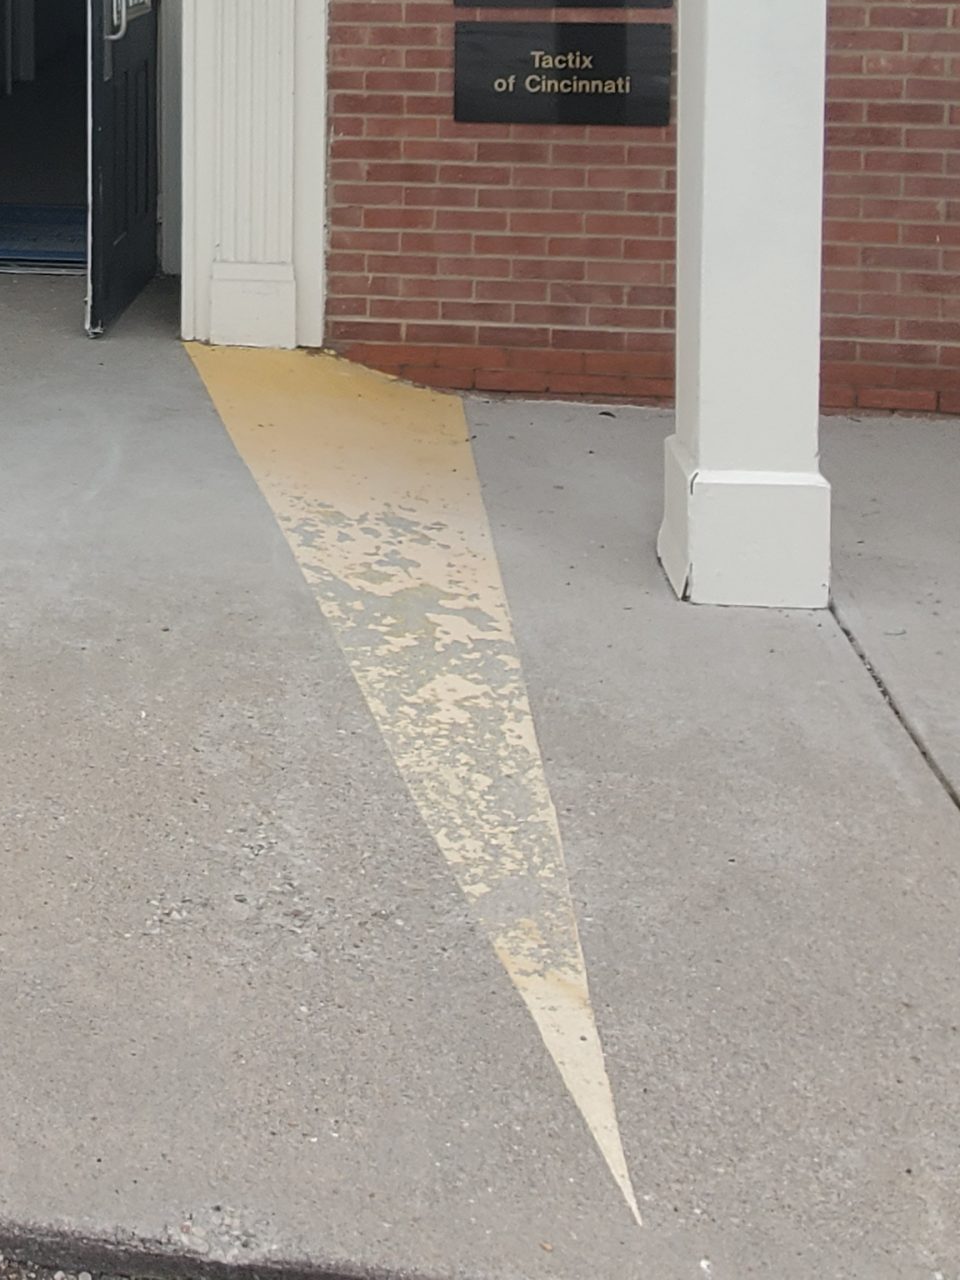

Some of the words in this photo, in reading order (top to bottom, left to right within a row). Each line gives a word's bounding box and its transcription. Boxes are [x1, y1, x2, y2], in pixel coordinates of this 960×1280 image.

[531, 51, 593, 69] Tactix
[494, 76, 516, 93] of
[525, 75, 631, 94] Cincinnati
